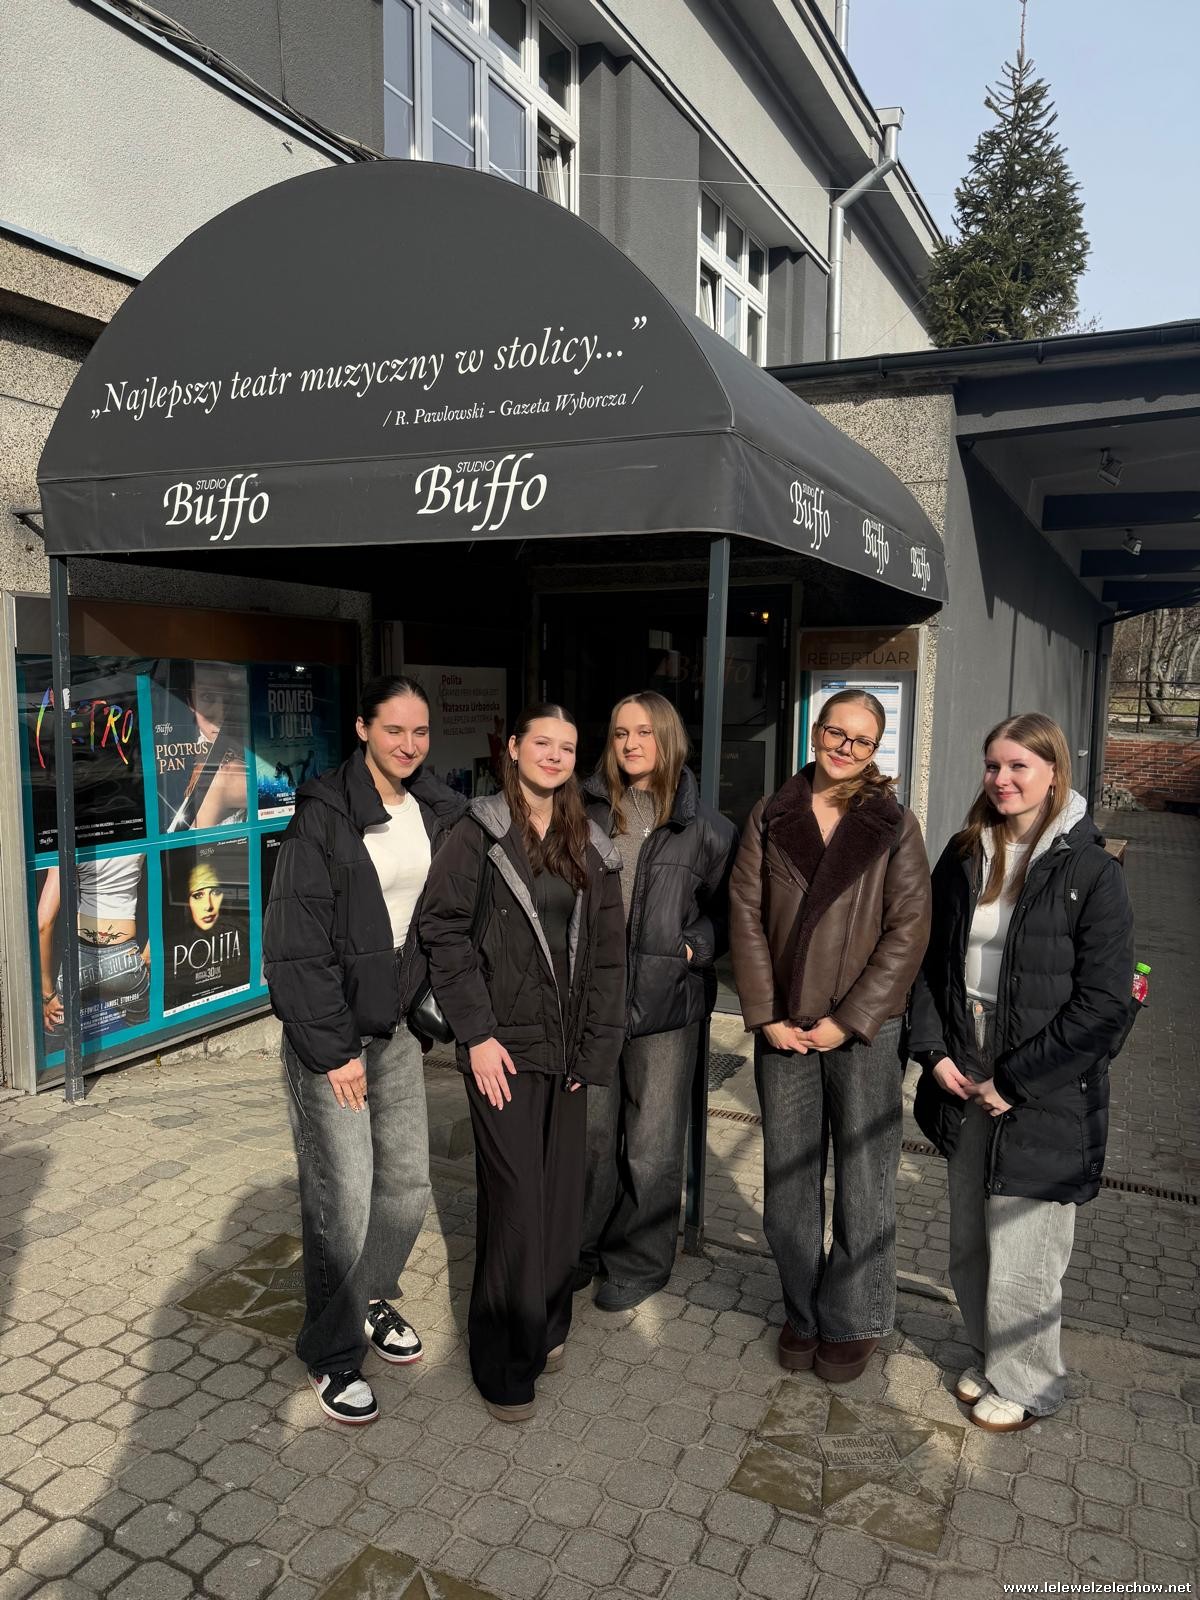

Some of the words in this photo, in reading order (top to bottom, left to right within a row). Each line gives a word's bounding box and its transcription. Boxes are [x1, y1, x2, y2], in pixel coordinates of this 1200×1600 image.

[230, 366, 293, 400] teatr
[299, 353, 445, 398] muzyczny
[454, 349, 484, 375] w
[395, 410, 410, 426] R.
[413, 401, 486, 425] Pawlowski
[499, 398, 551, 417] Gazeta
[555, 391, 627, 416] Wyborcza
[455, 459, 496, 474] STUDIO
[195, 478, 227, 491] STUDIO
[413, 452, 548, 532] Buffo
[163, 472, 270, 542] Buffo
[789, 479, 831, 551] Buffo
[862, 517, 890, 576] Buffo
[910, 546, 931, 592] Buffo
[807, 651, 910, 665] REPERTUAR
[441, 674, 462, 686] Polita
[267, 689, 314, 713] ROMEO
[442, 702, 470, 713] Natasza
[269, 715, 275, 739] I
[279, 714, 314, 739] JULIA
[159, 757, 186, 775] PAN
